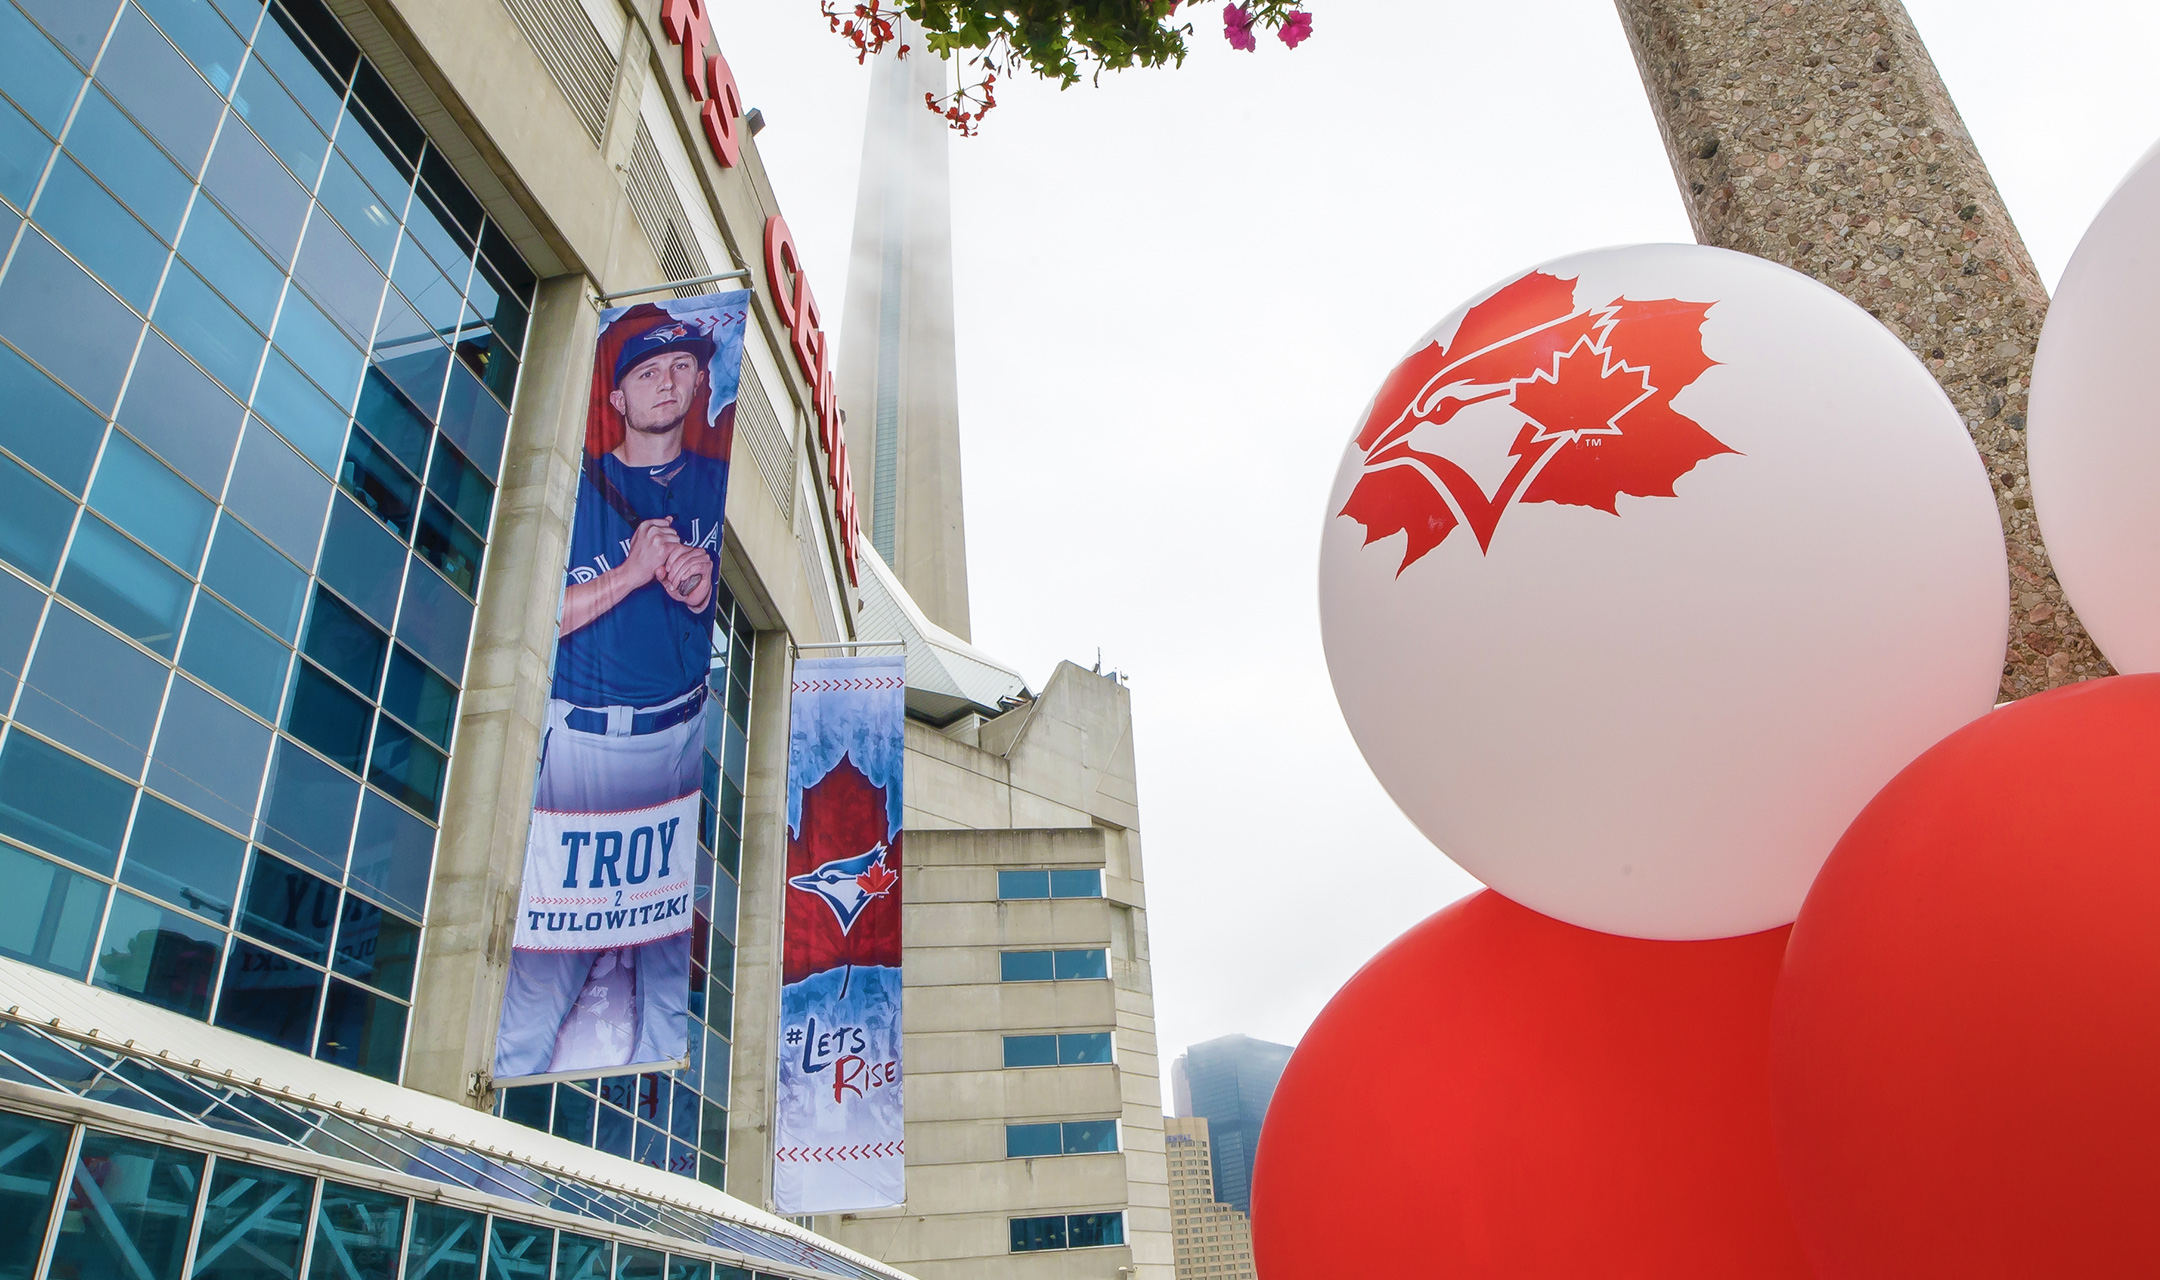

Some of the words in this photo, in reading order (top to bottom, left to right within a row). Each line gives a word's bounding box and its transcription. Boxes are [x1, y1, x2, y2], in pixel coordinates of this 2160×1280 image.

[561, 816, 680, 889] TROY
[528, 893, 689, 932] TULOWITZKI
[614, 890, 623, 907] 2
